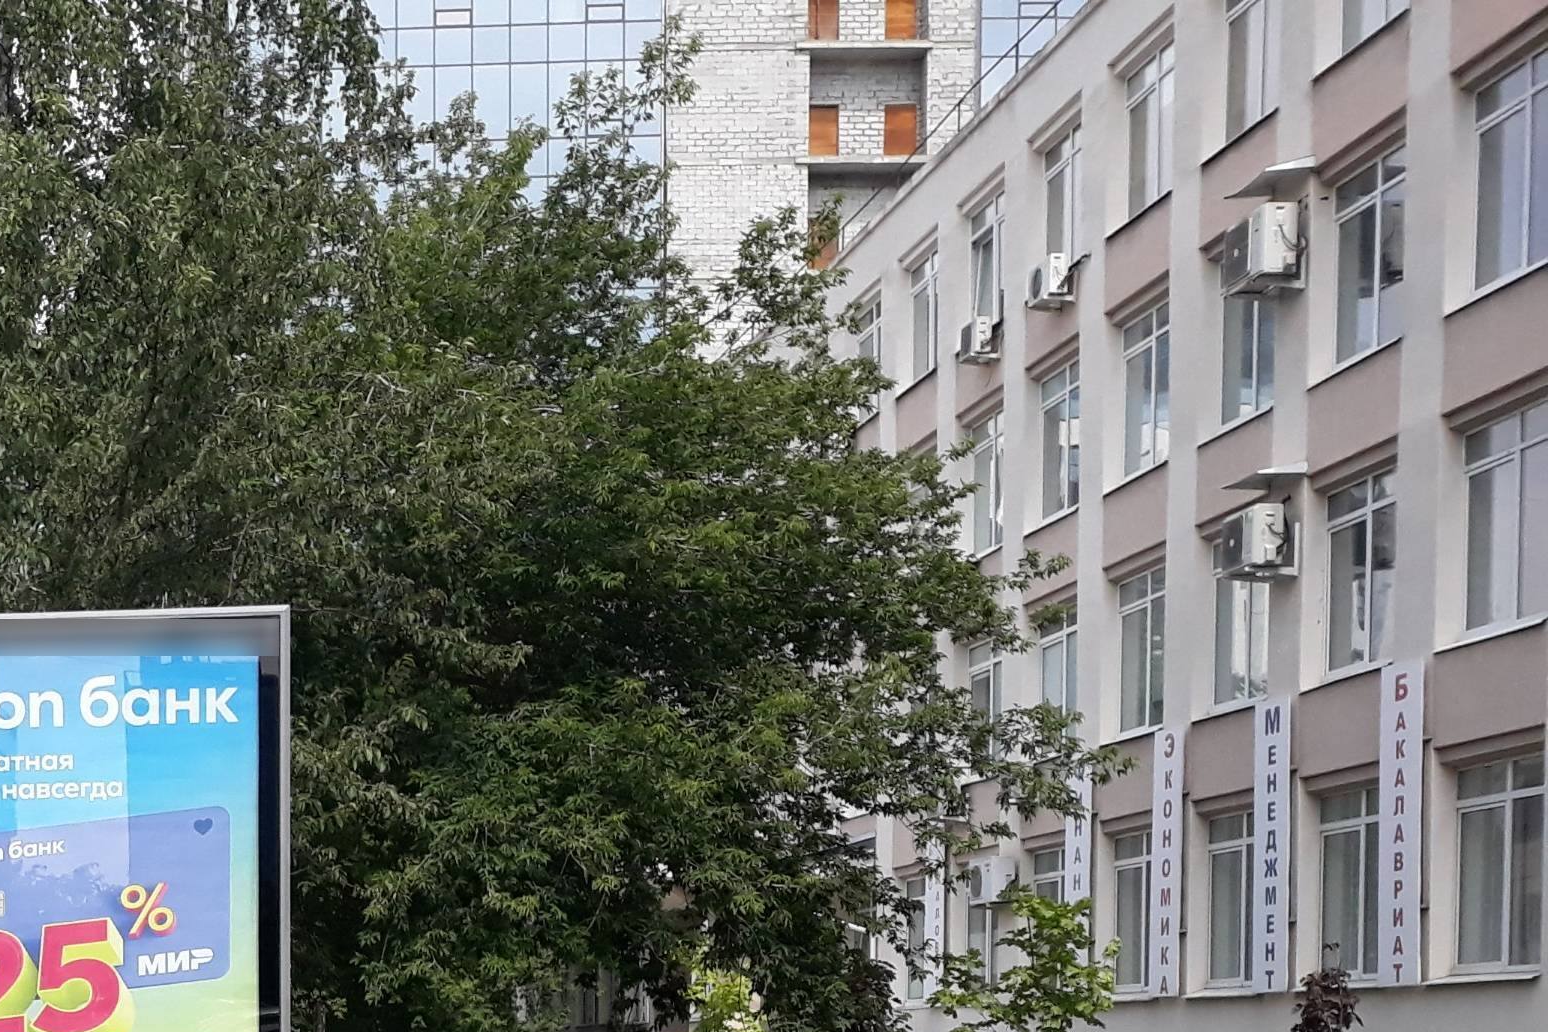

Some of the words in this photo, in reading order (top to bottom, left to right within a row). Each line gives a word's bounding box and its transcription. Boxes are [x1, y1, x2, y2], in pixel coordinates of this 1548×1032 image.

[79, 675, 239, 728] банк
[1, 779, 125, 801] навсегда
[8, 838, 66, 859] банк
[1263, 705, 1281, 990] МЕНЕДЖМЕНТ
[1392, 672, 1409, 984] БАКАЛАВРИАТ
[1159, 733, 1175, 995] ЭКОНОМИКА
[137, 948, 215, 978] МИР
